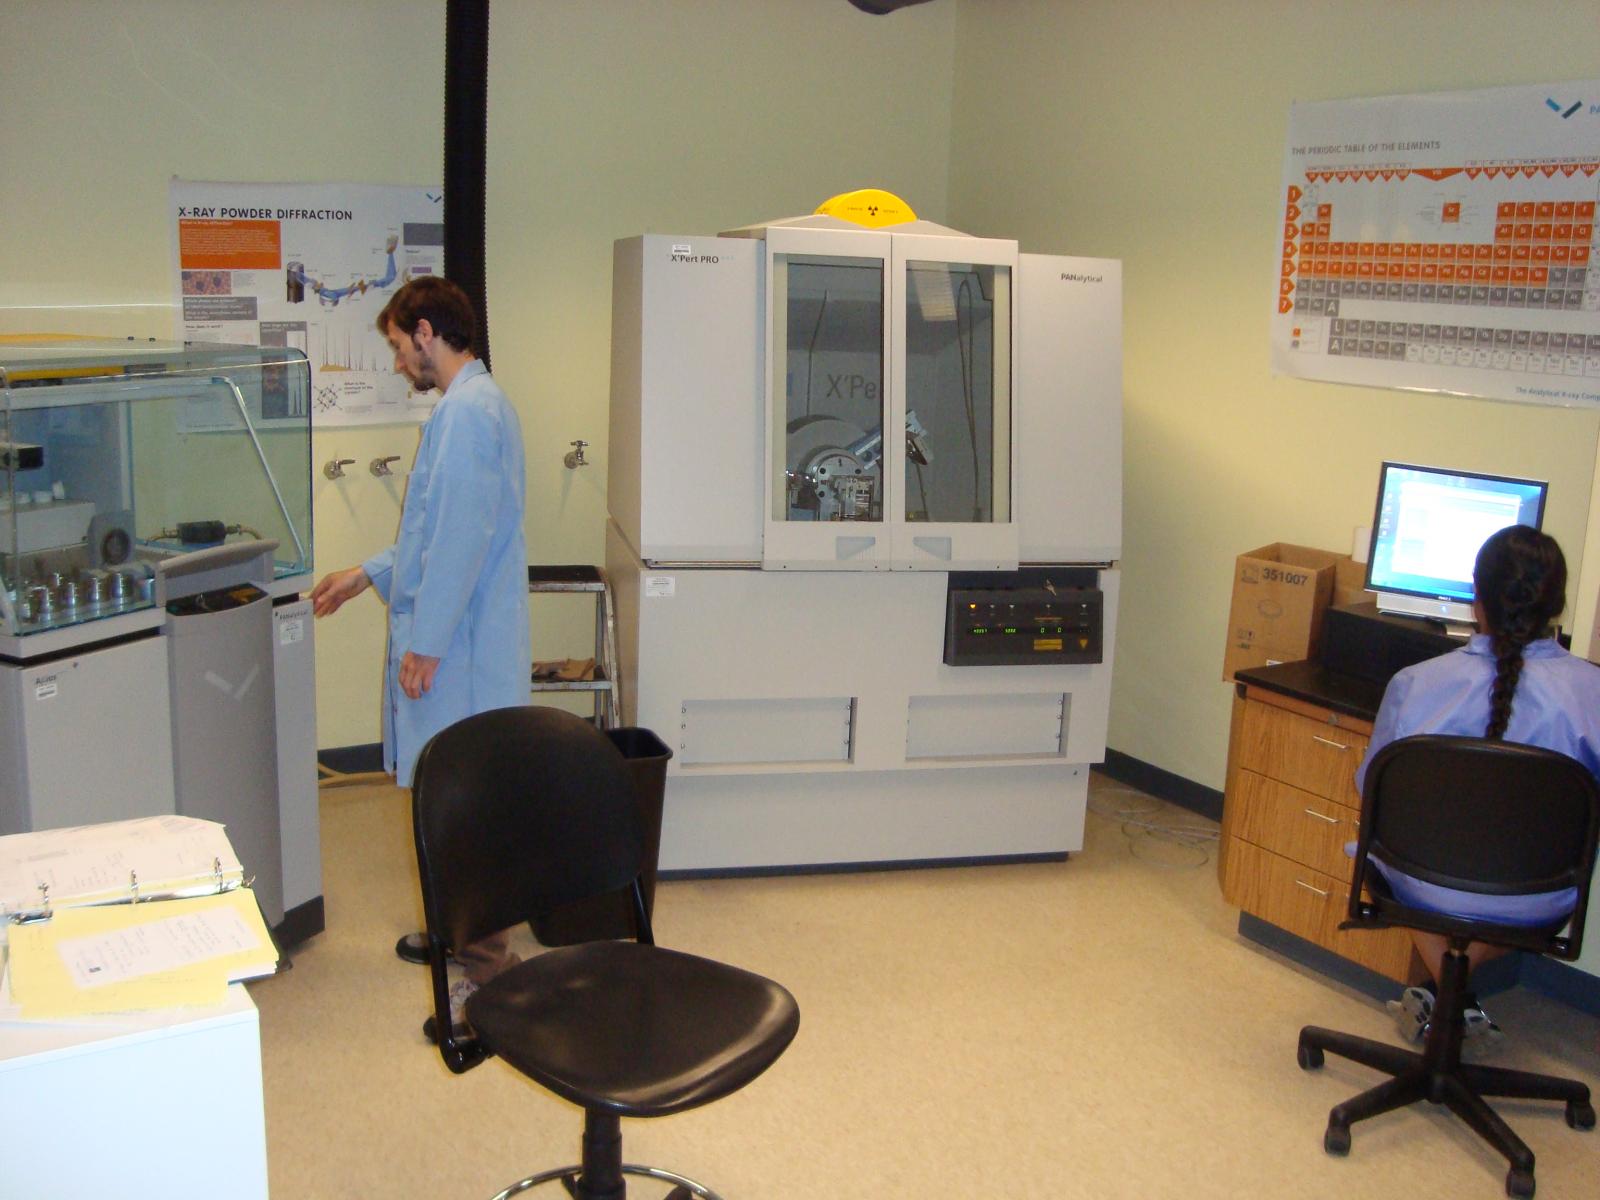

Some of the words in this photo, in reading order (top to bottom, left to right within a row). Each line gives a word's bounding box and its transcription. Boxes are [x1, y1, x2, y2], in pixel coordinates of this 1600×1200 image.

[1292, 147, 1306, 156] THE
[1308, 146, 1341, 155] PERIODIC
[1344, 144, 1365, 153] TABLE
[1368, 143, 1378, 152] OF
[1381, 143, 1395, 152] THE
[1398, 141, 1440, 151] ELEMENTS
[178, 207, 216, 217] X-RAY
[221, 208, 272, 218] POWDER
[277, 209, 353, 220] DIFFRACTION
[1285, 245, 1292, 254] 4
[672, 254, 698, 263] X'Pert
[701, 256, 719, 264] PRO
[1285, 264, 1290, 272] 5
[1283, 283, 1289, 291] 6
[1282, 301, 1287, 309] 7
[1328, 302, 1336, 313] A
[1335, 320, 1341, 332] L
[1331, 339, 1339, 351] A
[827, 374, 876, 399] X'Pe
[1263, 567, 1308, 586] 351007
